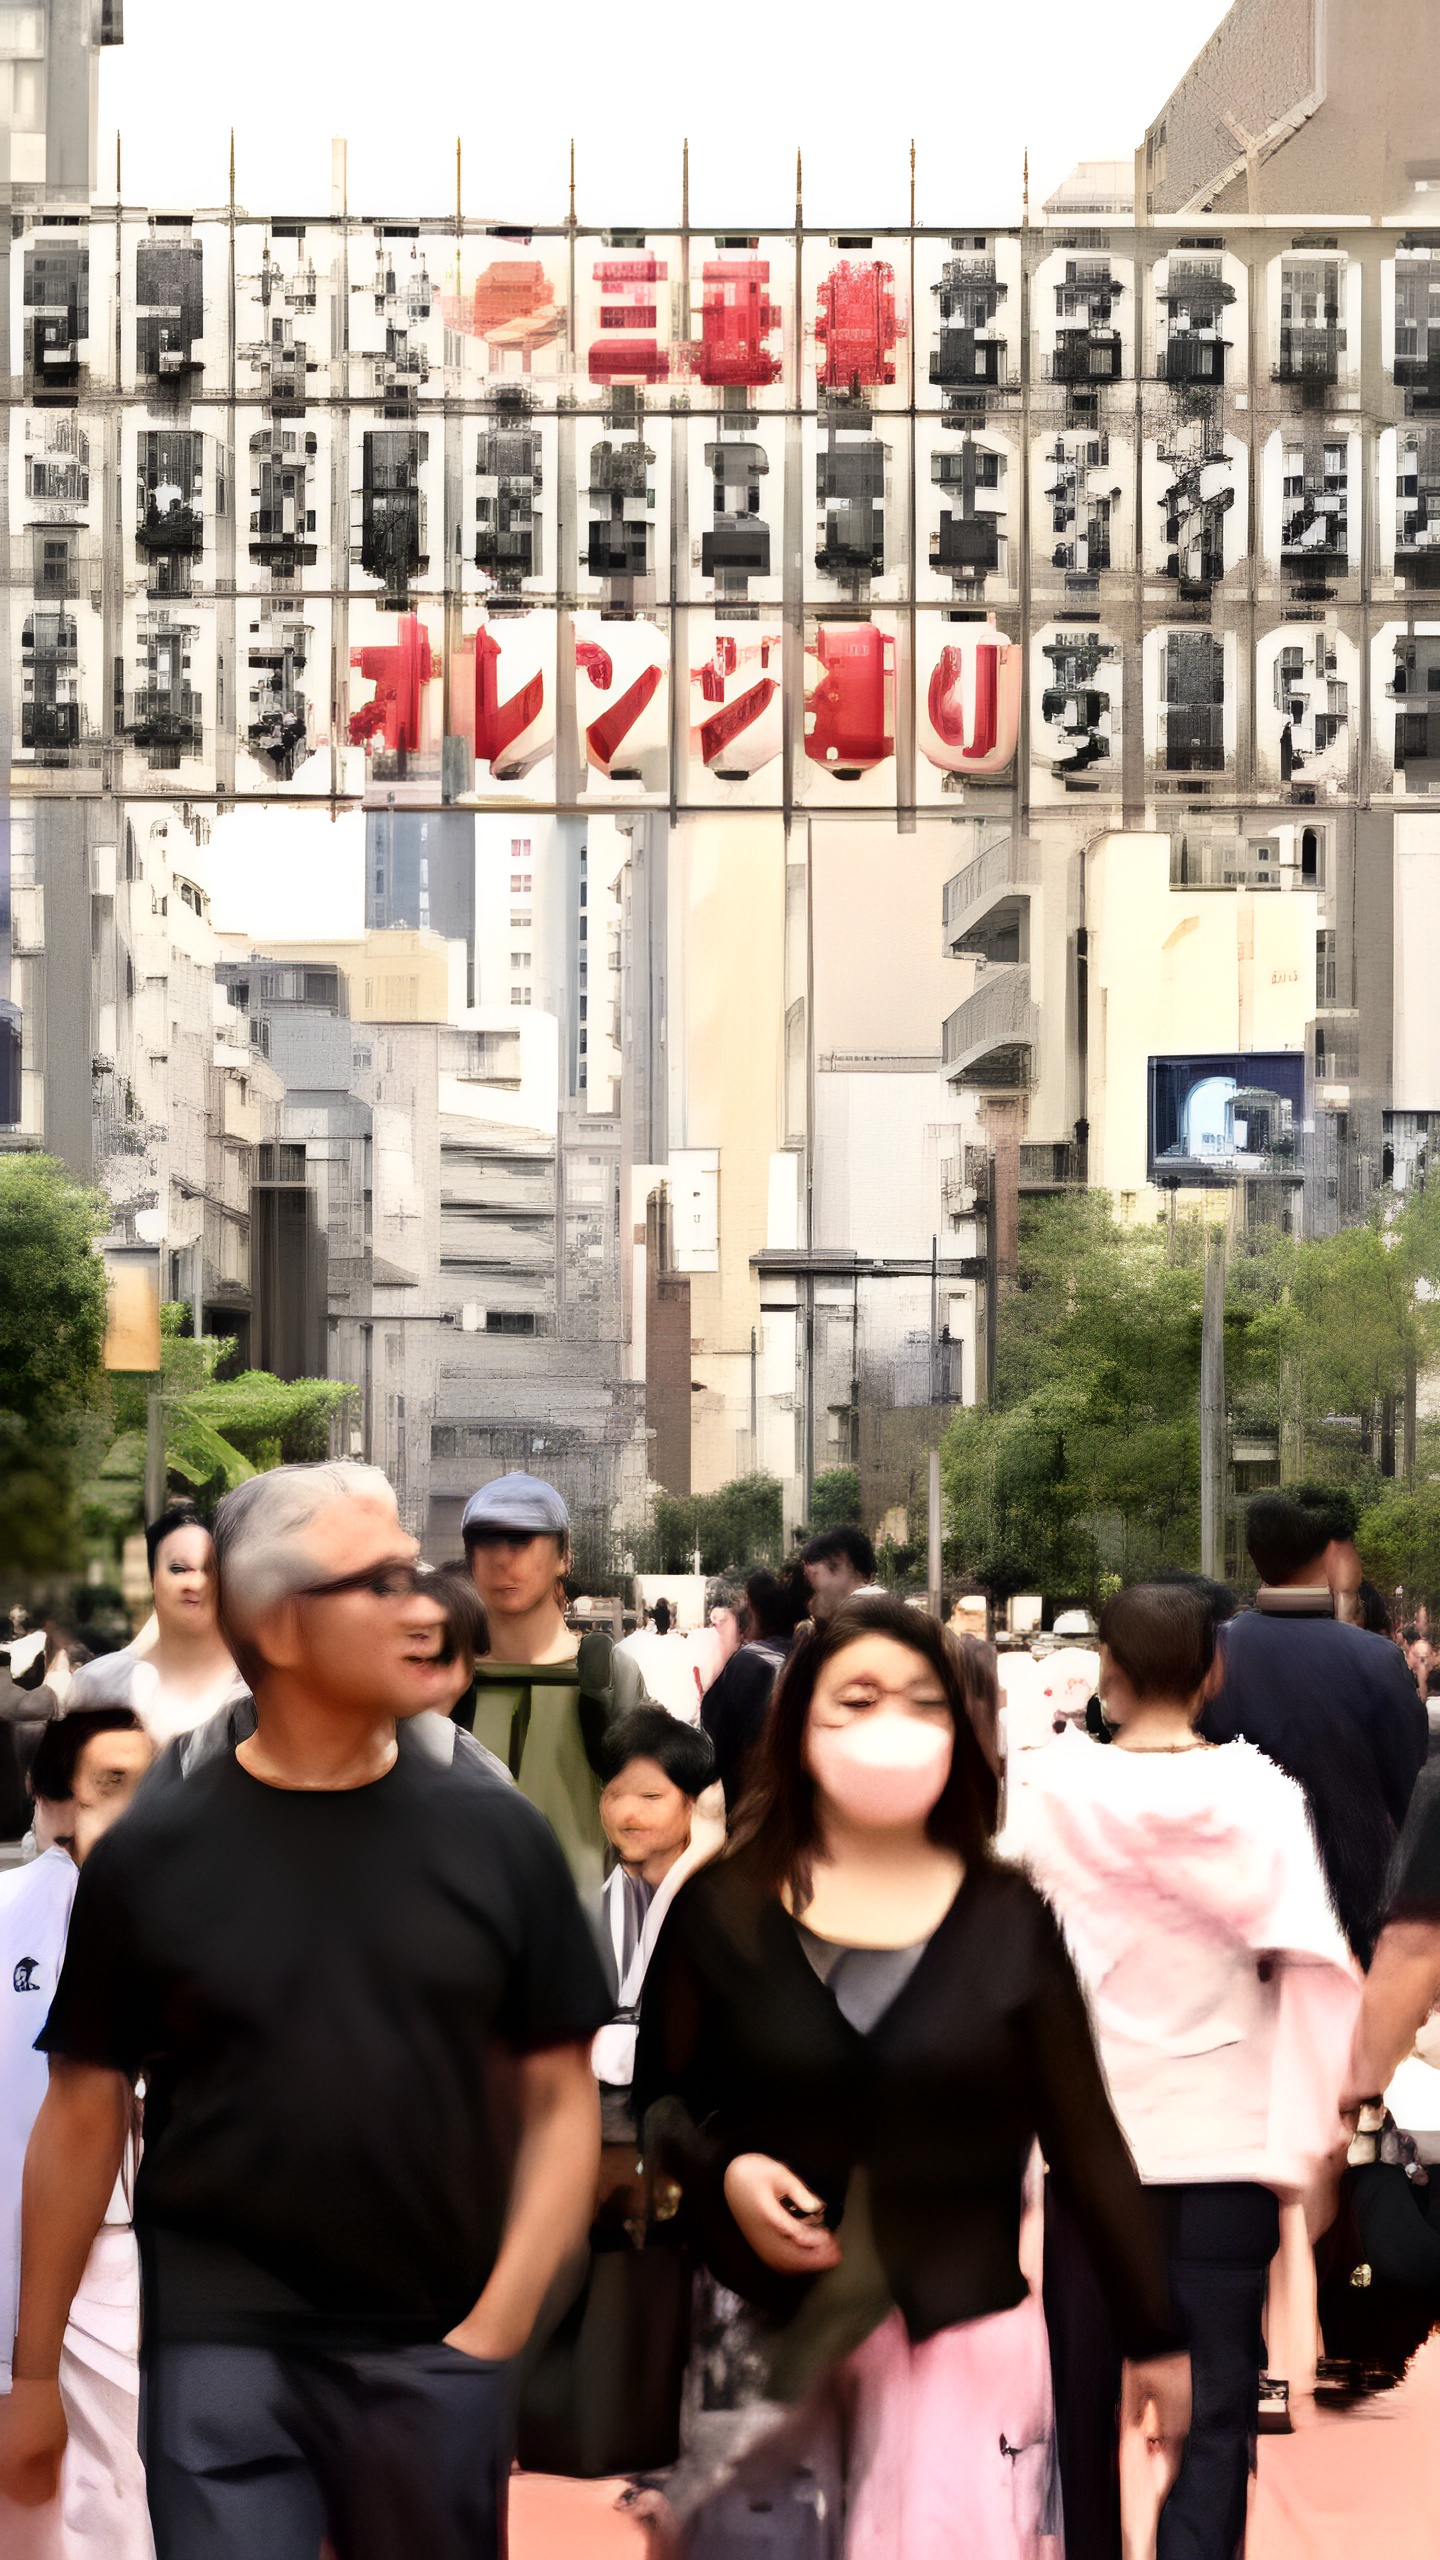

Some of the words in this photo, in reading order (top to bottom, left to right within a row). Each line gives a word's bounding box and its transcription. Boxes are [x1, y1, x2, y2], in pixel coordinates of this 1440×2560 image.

[350, 606, 1003, 764] オレンジ通り
